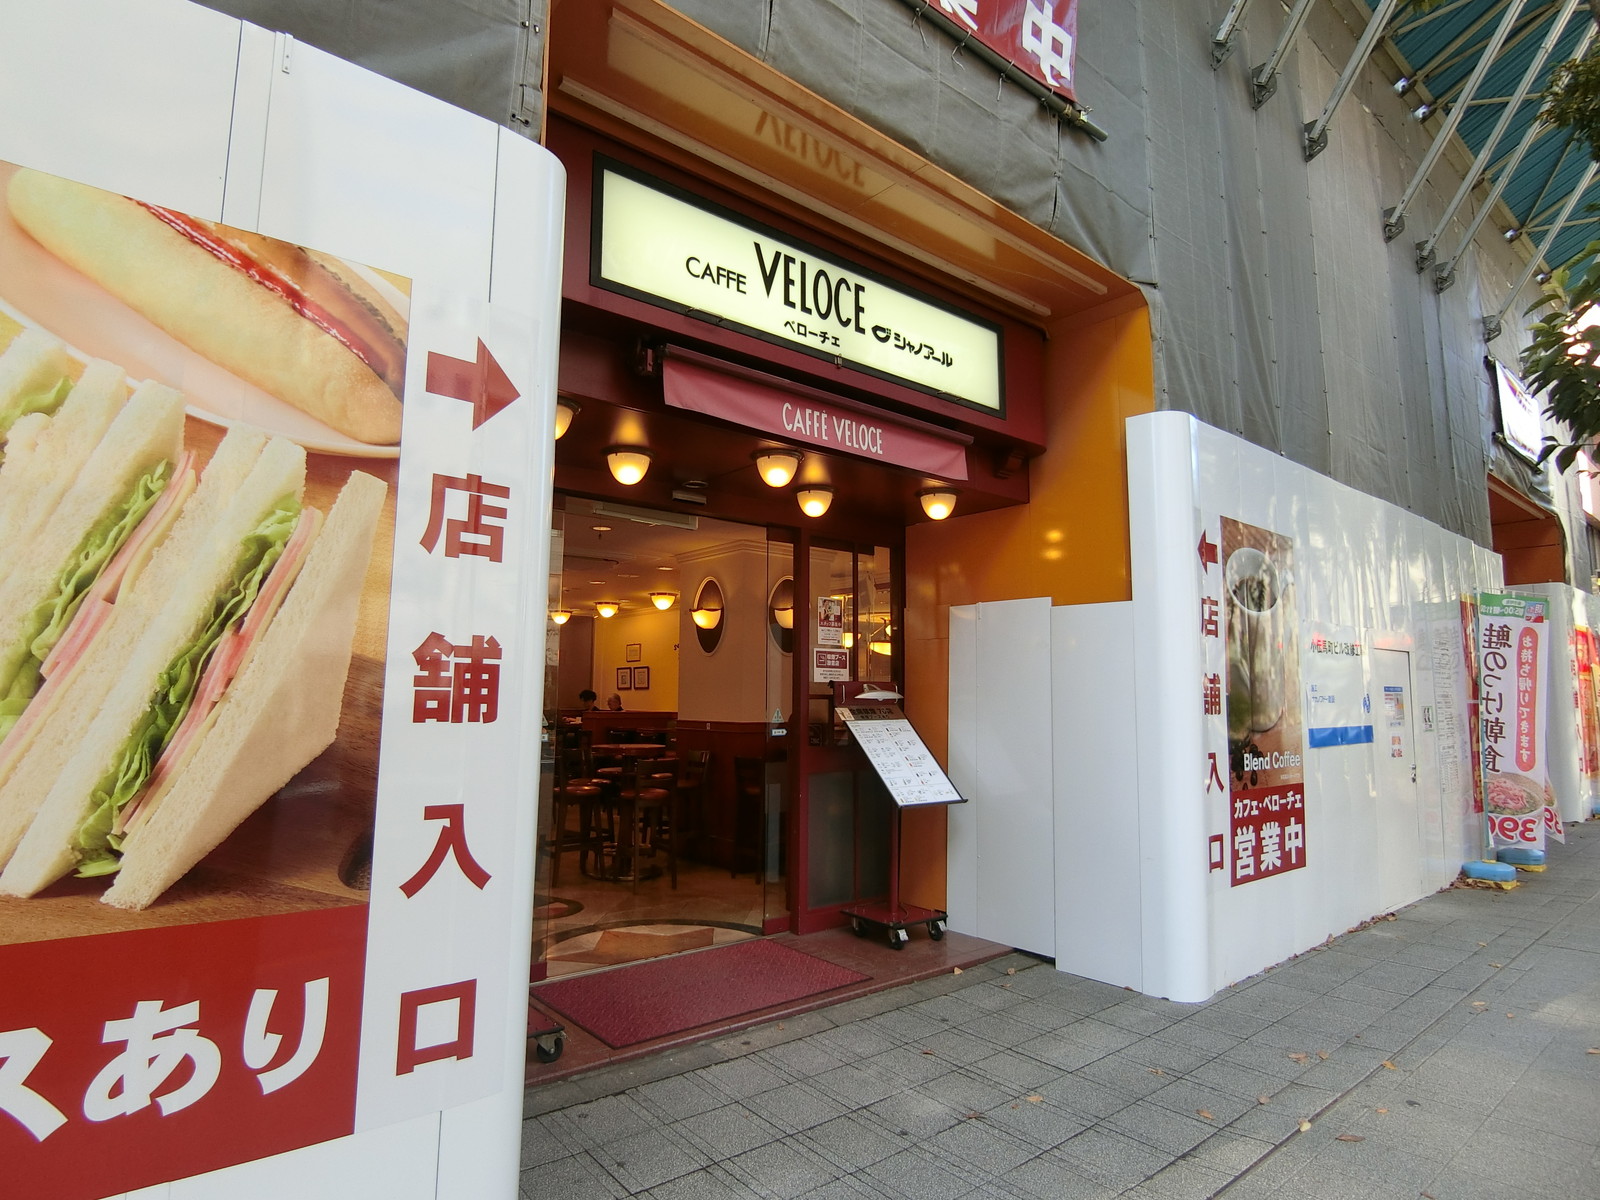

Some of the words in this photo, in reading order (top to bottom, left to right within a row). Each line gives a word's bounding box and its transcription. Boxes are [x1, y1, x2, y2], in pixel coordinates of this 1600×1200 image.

[685, 256, 747, 295] CAFFE
[753, 241, 866, 335] VELOCE
[784, 320, 841, 348] ベローチェ
[894, 332, 953, 368] シャノアール
[832, 415, 883, 455] VELOCE
[1200, 595, 1225, 874] 店舗入口
[396, 473, 512, 1077] 店舗入口
[1243, 752, 1271, 772] Blend
[1272, 750, 1301, 769] Coffee
[1233, 790, 1303, 819] カフェ・ベローチェ
[1234, 817, 1304, 879] 営業中
